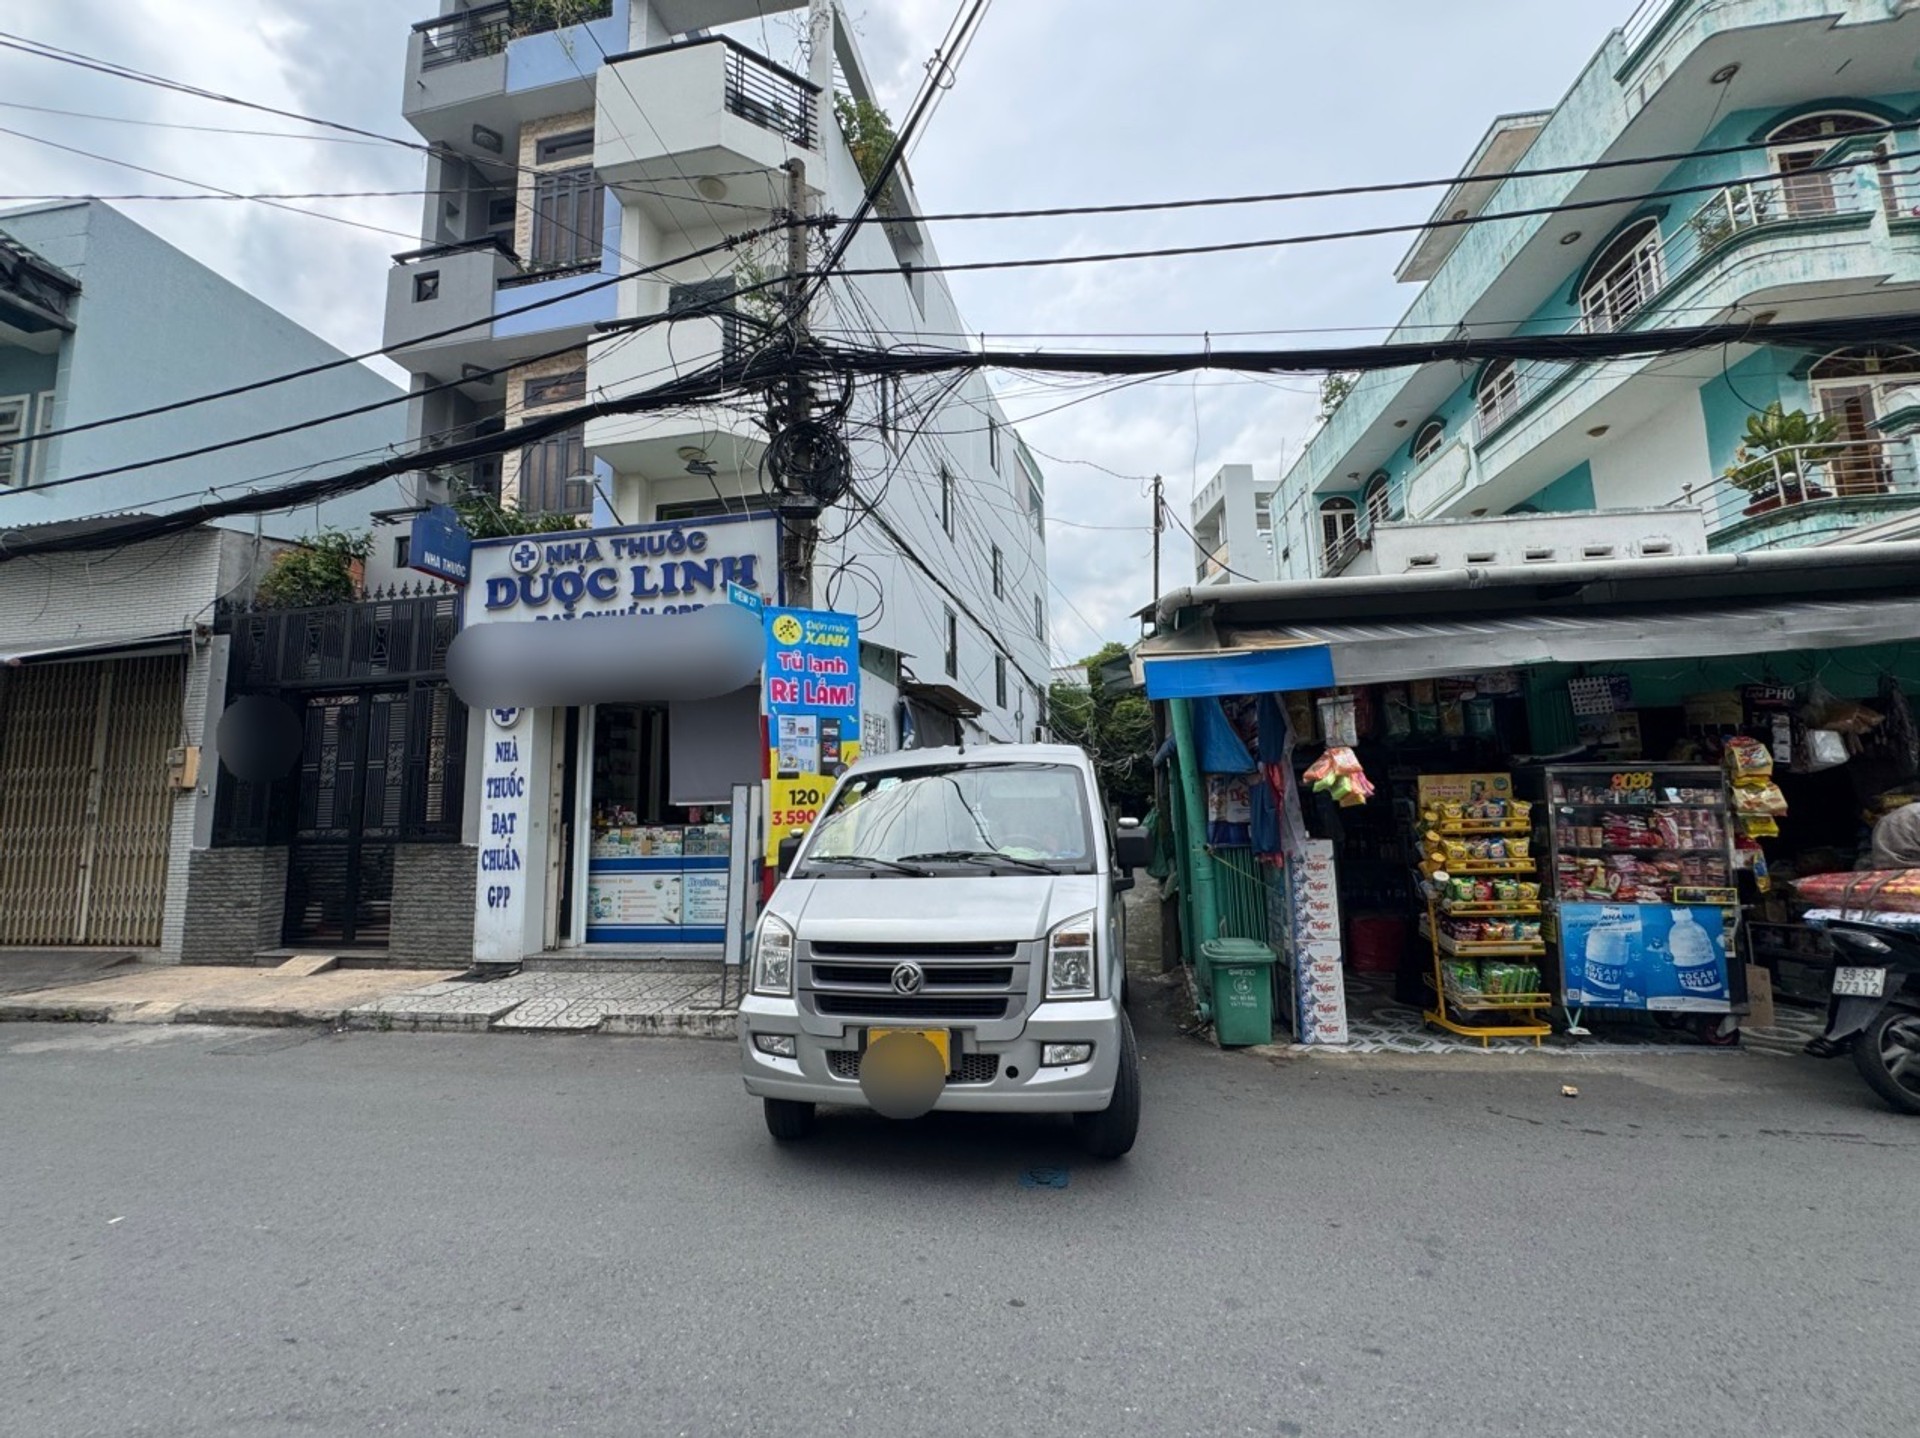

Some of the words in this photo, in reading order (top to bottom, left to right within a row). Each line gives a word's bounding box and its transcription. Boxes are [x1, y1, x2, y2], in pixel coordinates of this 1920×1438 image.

[546, 538, 602, 565] NHÀ
[610, 524, 707, 559] THUỐC
[485, 564, 618, 611] DƯỢC
[630, 554, 758, 599] LINH
[804, 631, 850, 647] XANH
[777, 649, 804, 671] Tủ
[807, 653, 848, 678] lạnh
[495, 736, 518, 762] NHÀ
[486, 768, 524, 798] THUỐC
[1611, 772, 1653, 792] 2026
[789, 788, 819, 806] 120
[491, 812, 517, 839] ĐẠT
[482, 838, 521, 871] CHUẨN
[488, 885, 511, 908] GPP
[1678, 970, 1717, 980] POCARI
